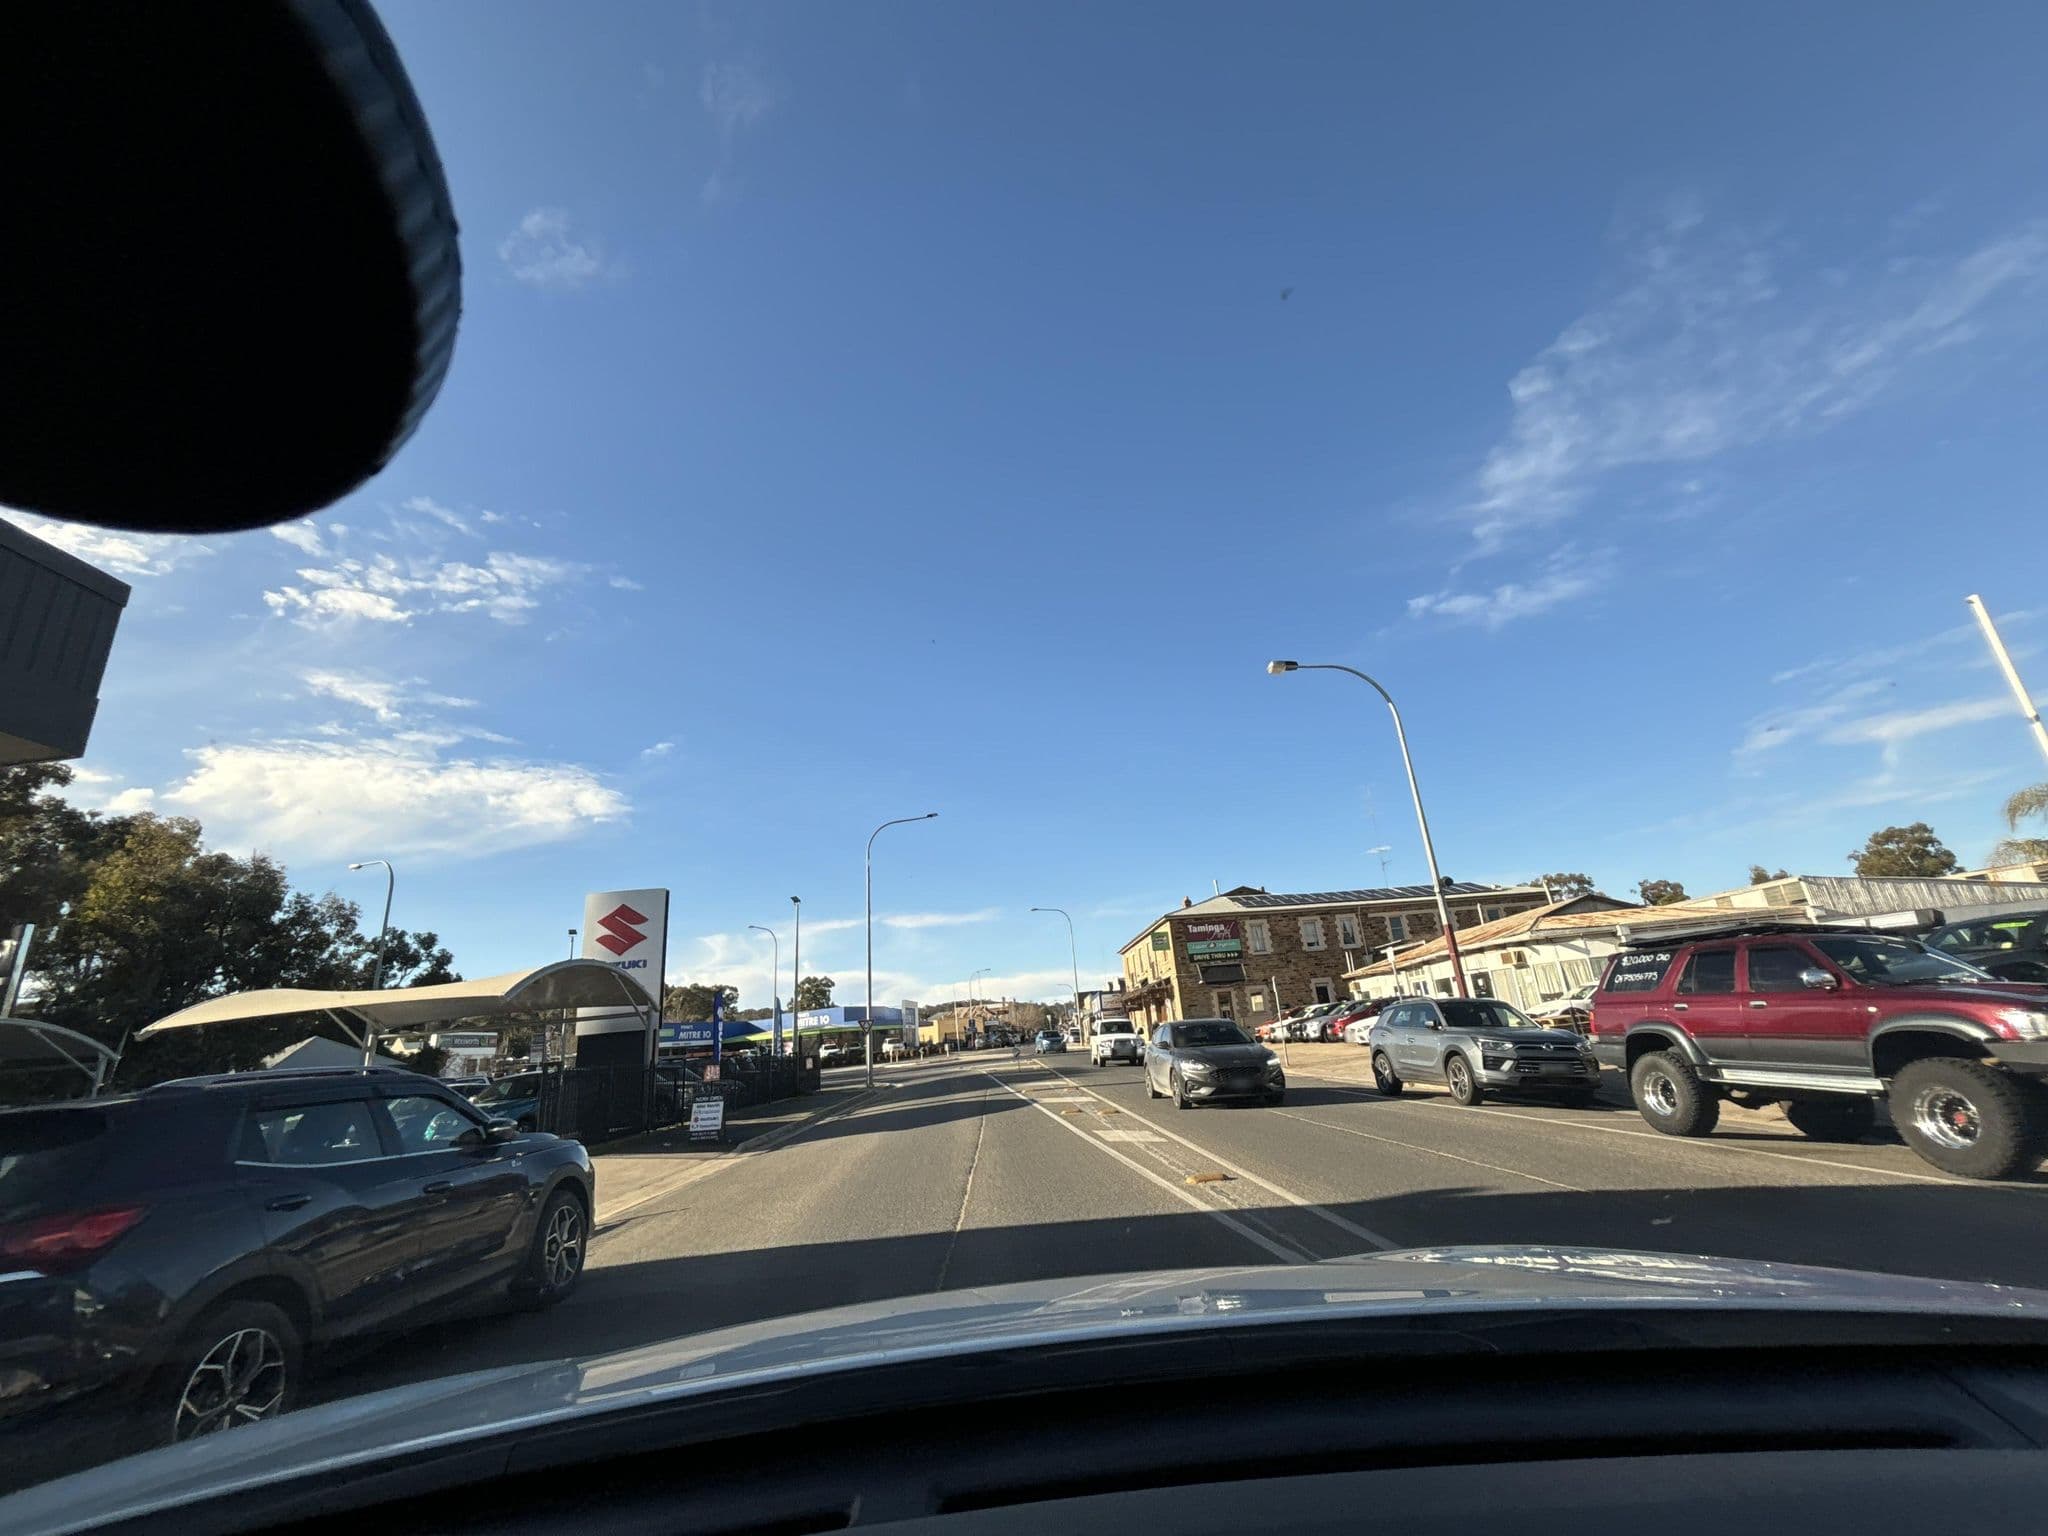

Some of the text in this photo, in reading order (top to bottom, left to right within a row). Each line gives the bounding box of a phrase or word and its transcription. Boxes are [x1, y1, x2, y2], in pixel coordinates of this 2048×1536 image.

[1187, 924, 1225, 933] Taminga
[819, 1015, 830, 1025] 10
[678, 1030, 712, 1040] MITRE 10
